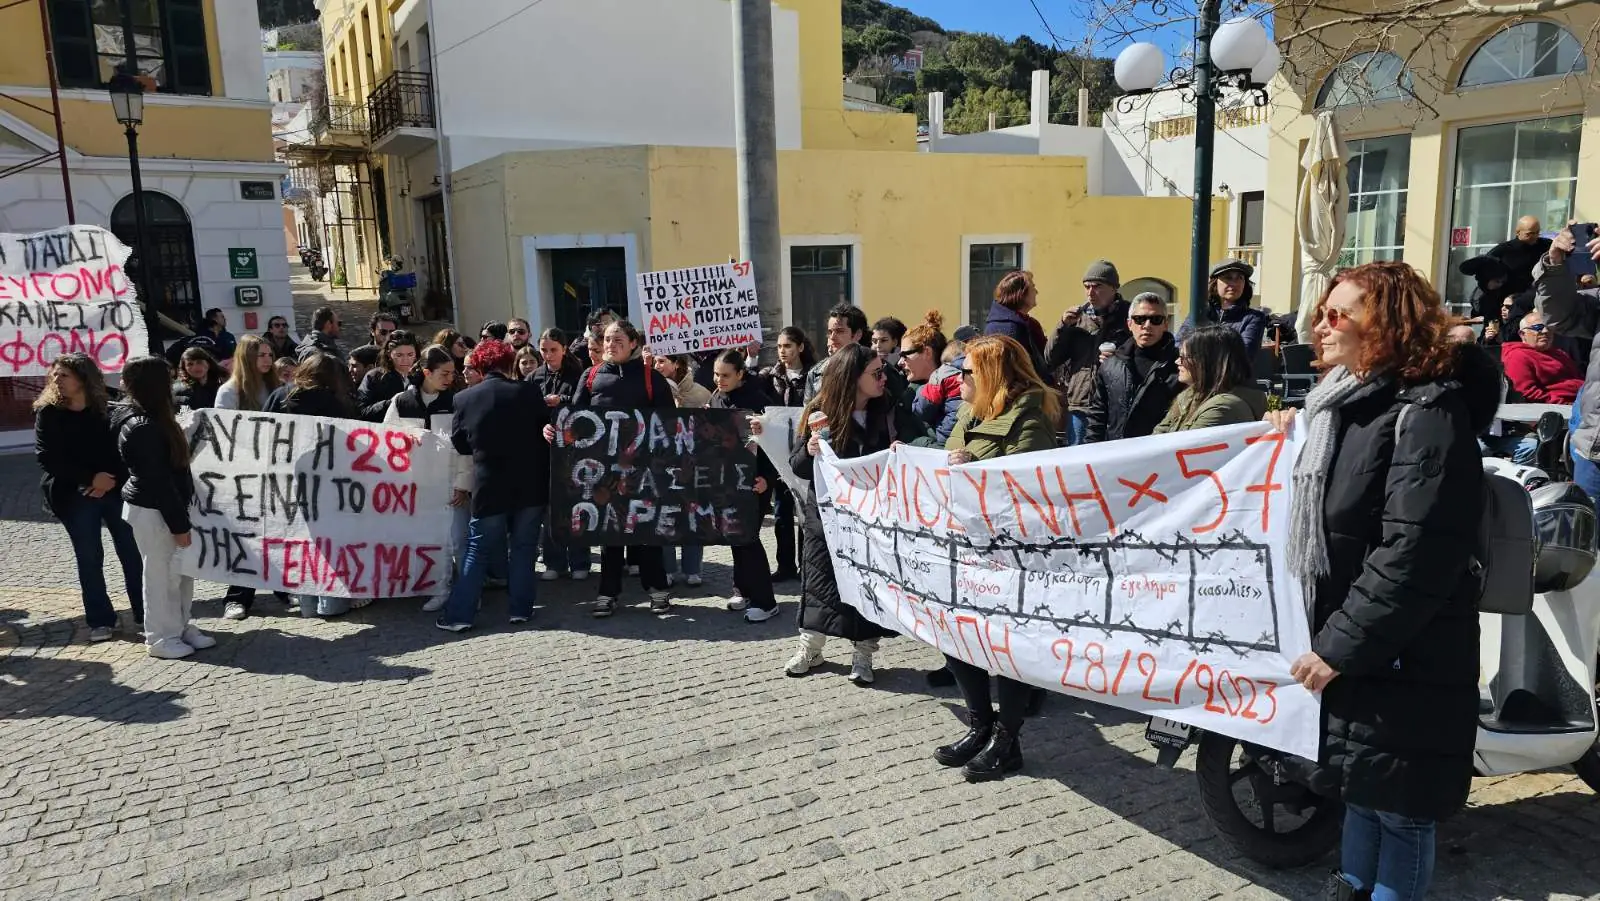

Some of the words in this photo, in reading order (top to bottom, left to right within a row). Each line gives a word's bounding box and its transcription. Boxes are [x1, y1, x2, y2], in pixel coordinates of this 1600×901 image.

[733, 260, 751, 277] 57
[644, 286, 667, 300] ΤΟ
[671, 278, 737, 298] ΣΥΣΤΗΜΑ
[644, 299, 671, 313] ΤΟΥ
[676, 291, 733, 310] ΚΕΡΔΟΥΣ
[737, 289, 755, 302] ΜΕ
[98, 300, 135, 332] ΤΟ
[649, 312, 692, 335] ΑΙΜΑ
[694, 305, 759, 325] ΠΟΤΙΣΜΕΝΟ
[650, 332, 674, 344] ΠΟΤΕ
[678, 331, 689, 340] ΔΕ
[693, 329, 705, 337] ΘΑ
[708, 321, 759, 335] ΞΕΧΑΣΟΥΜΕ
[0, 329, 129, 373] ΦΟΝΟ
[683, 340, 700, 351] ΤΟ
[703, 334, 755, 348] ΕΓΚΛΗΜΑ
[190, 411, 296, 465] ΑΥΤΗ
[313, 422, 335, 470] Η
[571, 458, 751, 501] ΦΤΑΣΕΙΣ
[1175, 432, 1285, 534] 57
[234, 472, 320, 526] ΕΙΝΑΙ
[331, 477, 366, 514] ΤΟ
[372, 481, 417, 516] ΟΧΙ
[571, 499, 681, 536] ΠΑΡΕ
[688, 501, 740, 537] ΜΕ
[192, 526, 258, 576] ΤΗΣ
[261, 536, 368, 593] ΓΕΝΙΑΣ
[371, 542, 442, 598] ΜΑΣ
[888, 584, 1023, 680] ΤΕΜΠΗ
[1050, 637, 1278, 725] 28/2/2023
